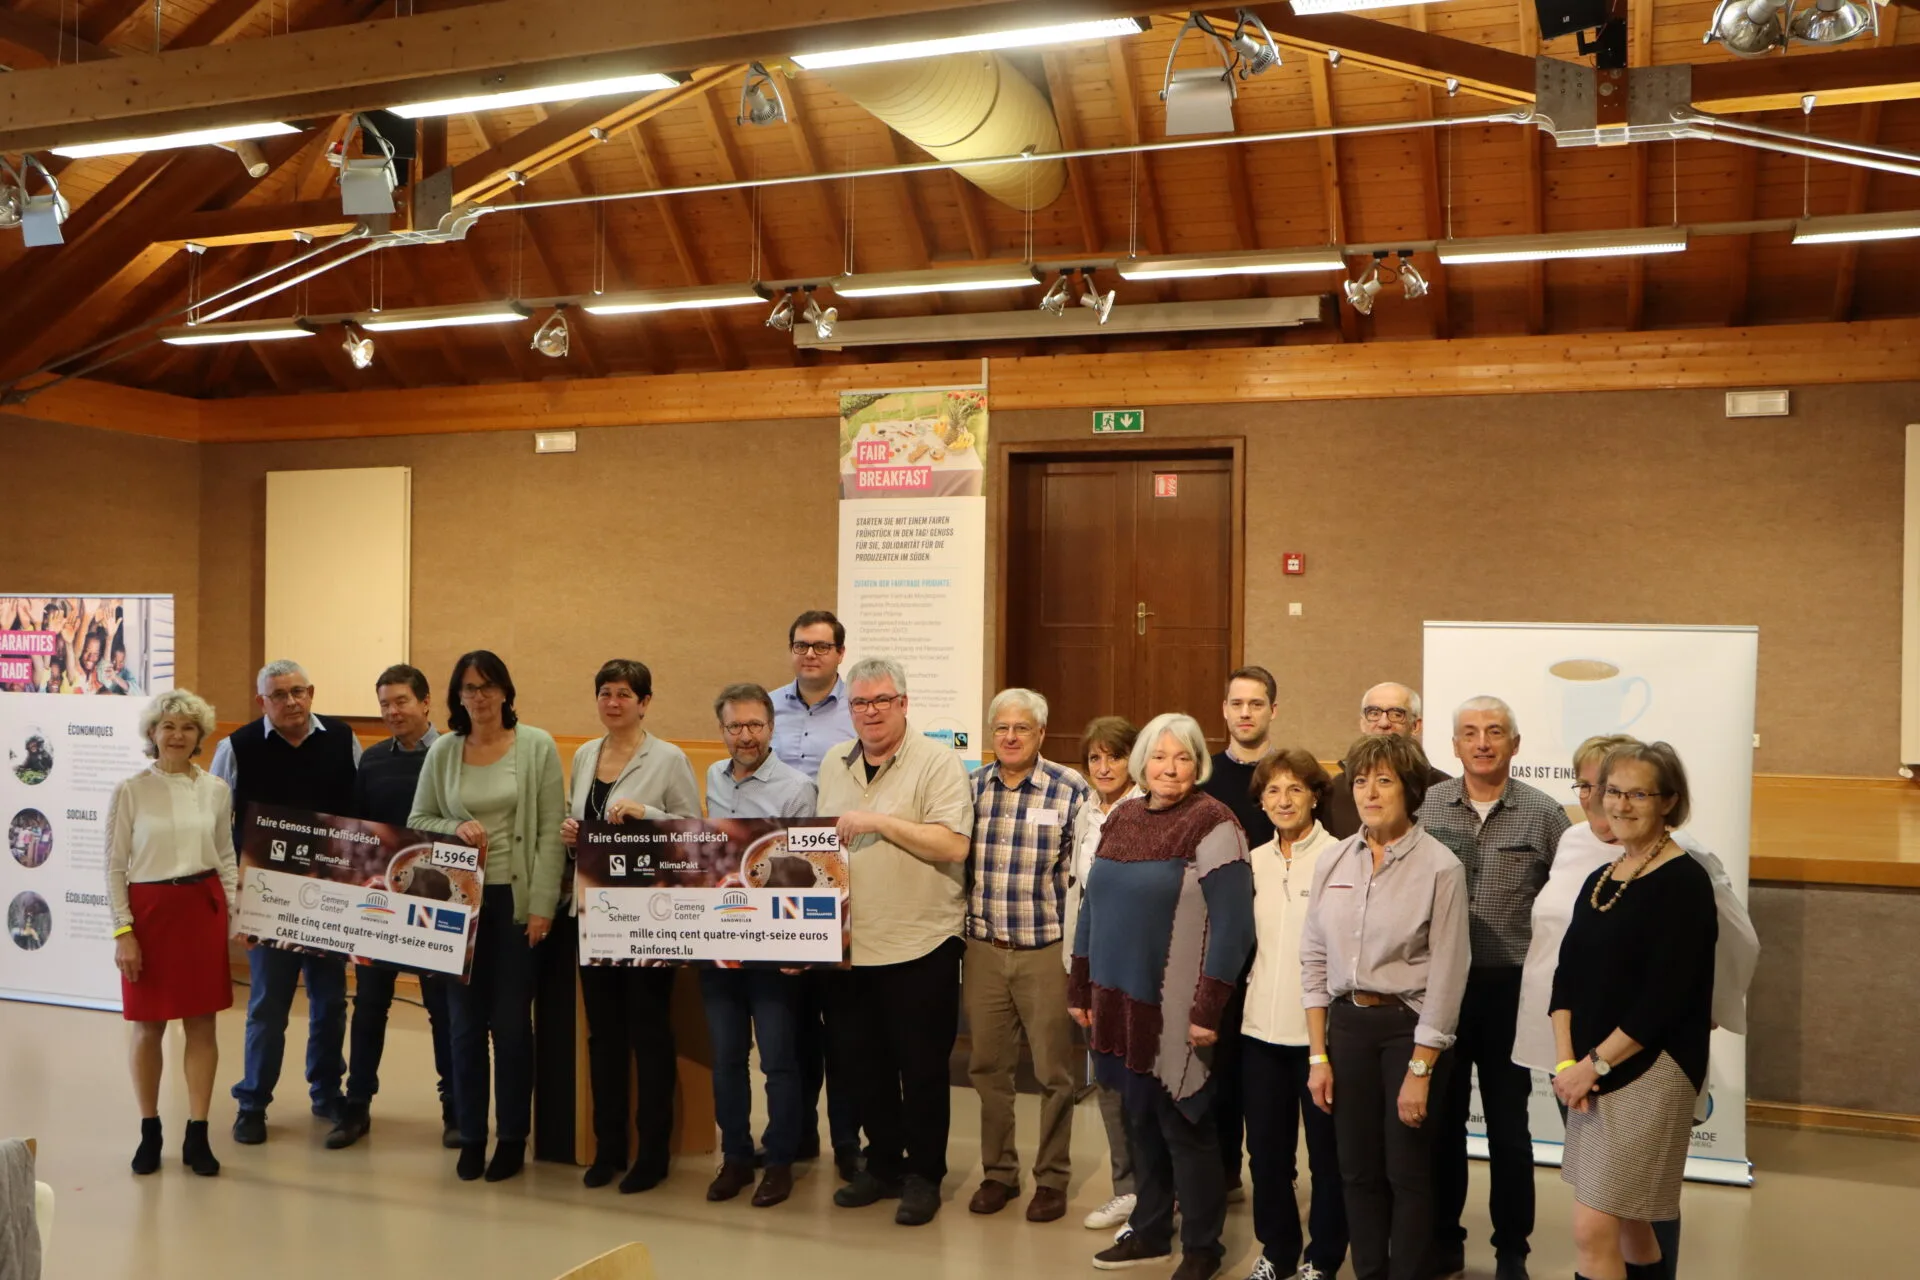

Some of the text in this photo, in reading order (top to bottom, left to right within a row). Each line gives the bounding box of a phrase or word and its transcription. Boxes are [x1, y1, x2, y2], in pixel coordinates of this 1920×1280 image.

[859, 444, 887, 461] FAIR
[859, 469, 929, 487] BREAKFAST
[856, 516, 950, 526] STARTEN SIE MIT EINEM FAIREN
[855, 528, 892, 538] FRÜHSTÜCK
[893, 529, 900, 537] IN
[901, 529, 914, 537] DEN
[929, 528, 954, 537] GENUSS
[855, 541, 867, 550] FÜR
[921, 540, 934, 549] FÜR
[934, 540, 945, 549] DIE
[855, 552, 930, 562] PRODUZENTEN IM SÜDEN
[0, 634, 54, 651] ARANTIES
[67, 721, 114, 738] ÉCONOMIQUES
[1511, 765, 1531, 778] DAS
[1534, 766, 1551, 779] IST
[66, 808, 98, 821] SOCIALES
[256, 815, 381, 846] Faire Genoss um Kaffisdësch
[588, 831, 729, 844] Faire Genoss um Kaffisdësch
[790, 832, 838, 848] 1.596€
[434, 849, 477, 867] 1.596€
[659, 861, 699, 870] KlimaPakt
[674, 903, 705, 913] Gemeng
[674, 912, 701, 920] Conter
[275, 926, 299, 940] CARE
[300, 931, 356, 953] Luxembourg
[277, 912, 300, 925] mille
[301, 917, 321, 930] cinq
[322, 920, 342, 932] cent
[343, 925, 426, 948] quatre-vingt-seize
[427, 940, 454, 953] euros
[629, 928, 829, 942] mille cinq cent quatre-vingt-seize euros
[629, 944, 694, 956] Rainforest.lu
